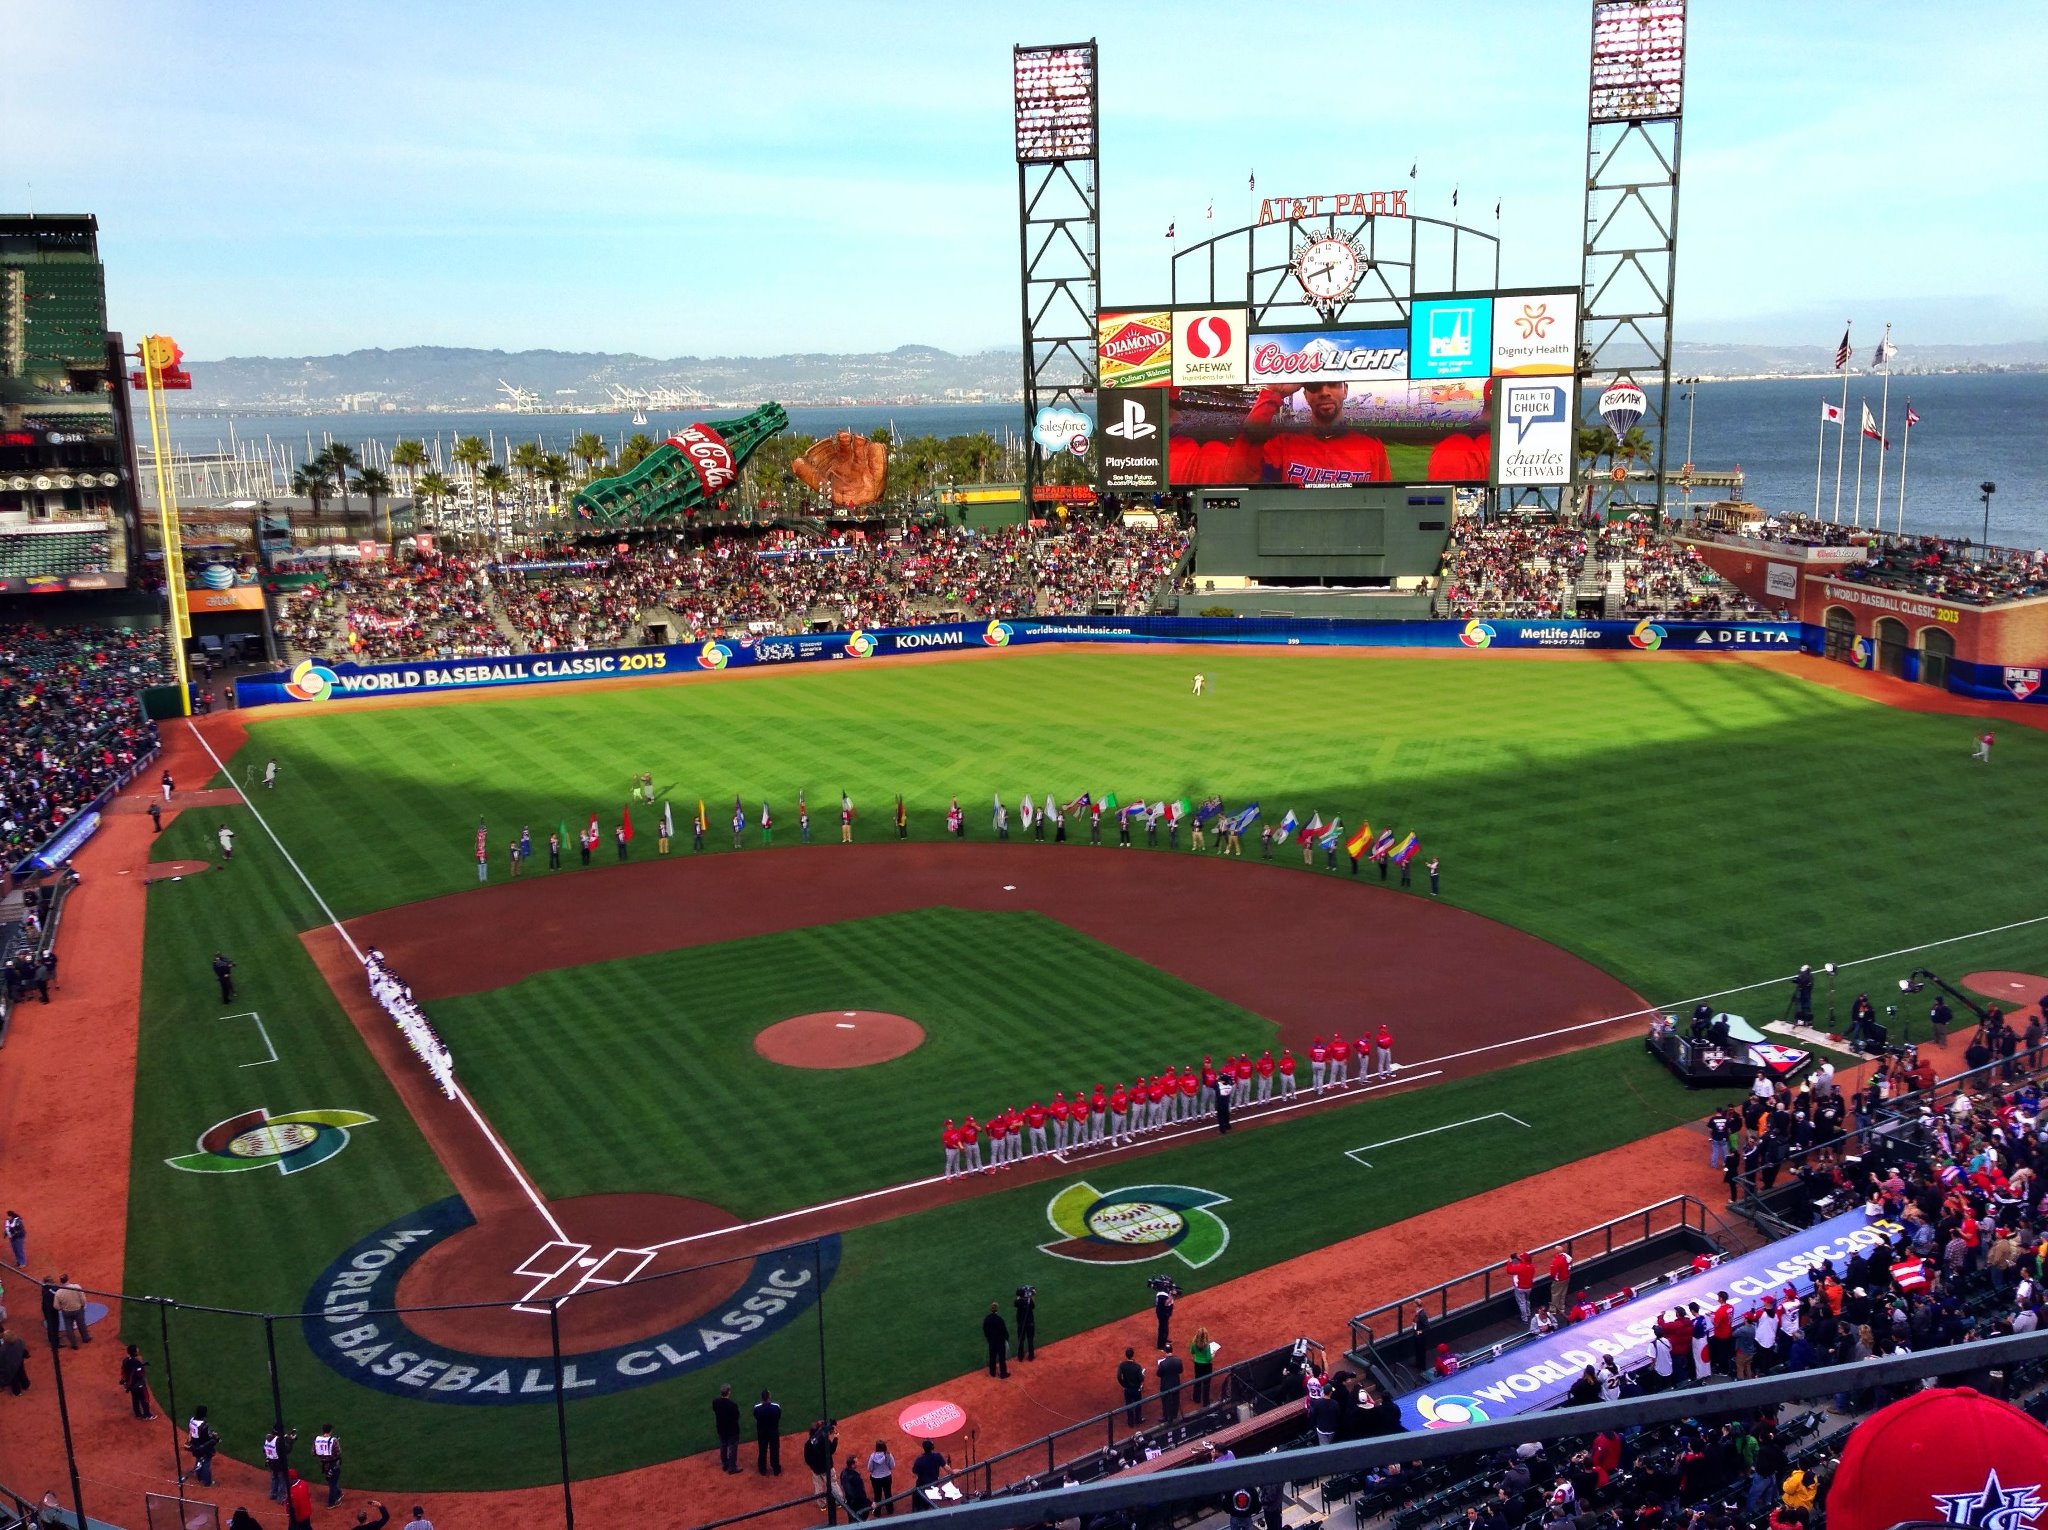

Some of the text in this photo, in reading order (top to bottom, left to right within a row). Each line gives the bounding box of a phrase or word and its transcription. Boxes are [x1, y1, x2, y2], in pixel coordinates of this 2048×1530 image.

[1258, 190, 1408, 226] AT&T PARK
[1288, 226, 1369, 277] SAN FRANCISCO
[1301, 288, 1356, 309] GIANTS
[1105, 331, 1166, 357] DIAMOND
[1498, 344, 1569, 358] Dignity Health
[1253, 342, 1403, 375] Coors LIGHT
[1185, 362, 1233, 374] SAFEWAY
[1120, 373, 1145, 384] Culinary
[1514, 392, 1551, 401] TALK TO
[1604, 392, 1642, 406] RE/MAX
[1514, 402, 1550, 413] CHUCK
[1039, 419, 1087, 437] salesforce
[66, 433, 86, 443] at&t
[671, 425, 734, 487] ca-Cola
[1105, 456, 1158, 469] PlayStation
[1506, 448, 1564, 466] charles
[1505, 466, 1564, 478] SCHWAB
[1833, 587, 1961, 625] WORLD BASEBALL CLASSIC 2013
[1025, 624, 1131, 636] worldbaseballclassic.com
[1520, 627, 1601, 639] MetLife Alico
[1719, 630, 1790, 643] DELTA
[896, 631, 963, 648] KONAMI
[755, 643, 796, 662] USA
[341, 652, 667, 692] WORLD BASEBALL CLASSIC 2013
[323, 1230, 433, 1324] WORLD
[1472, 1349, 1597, 1405] WORLD
[1729, 1245, 1846, 1297] CLASSIC
[1834, 1218, 1906, 1254] 2013
[615, 1268, 812, 1378] CLASSIC
[328, 1323, 597, 1394] BASEBALL
